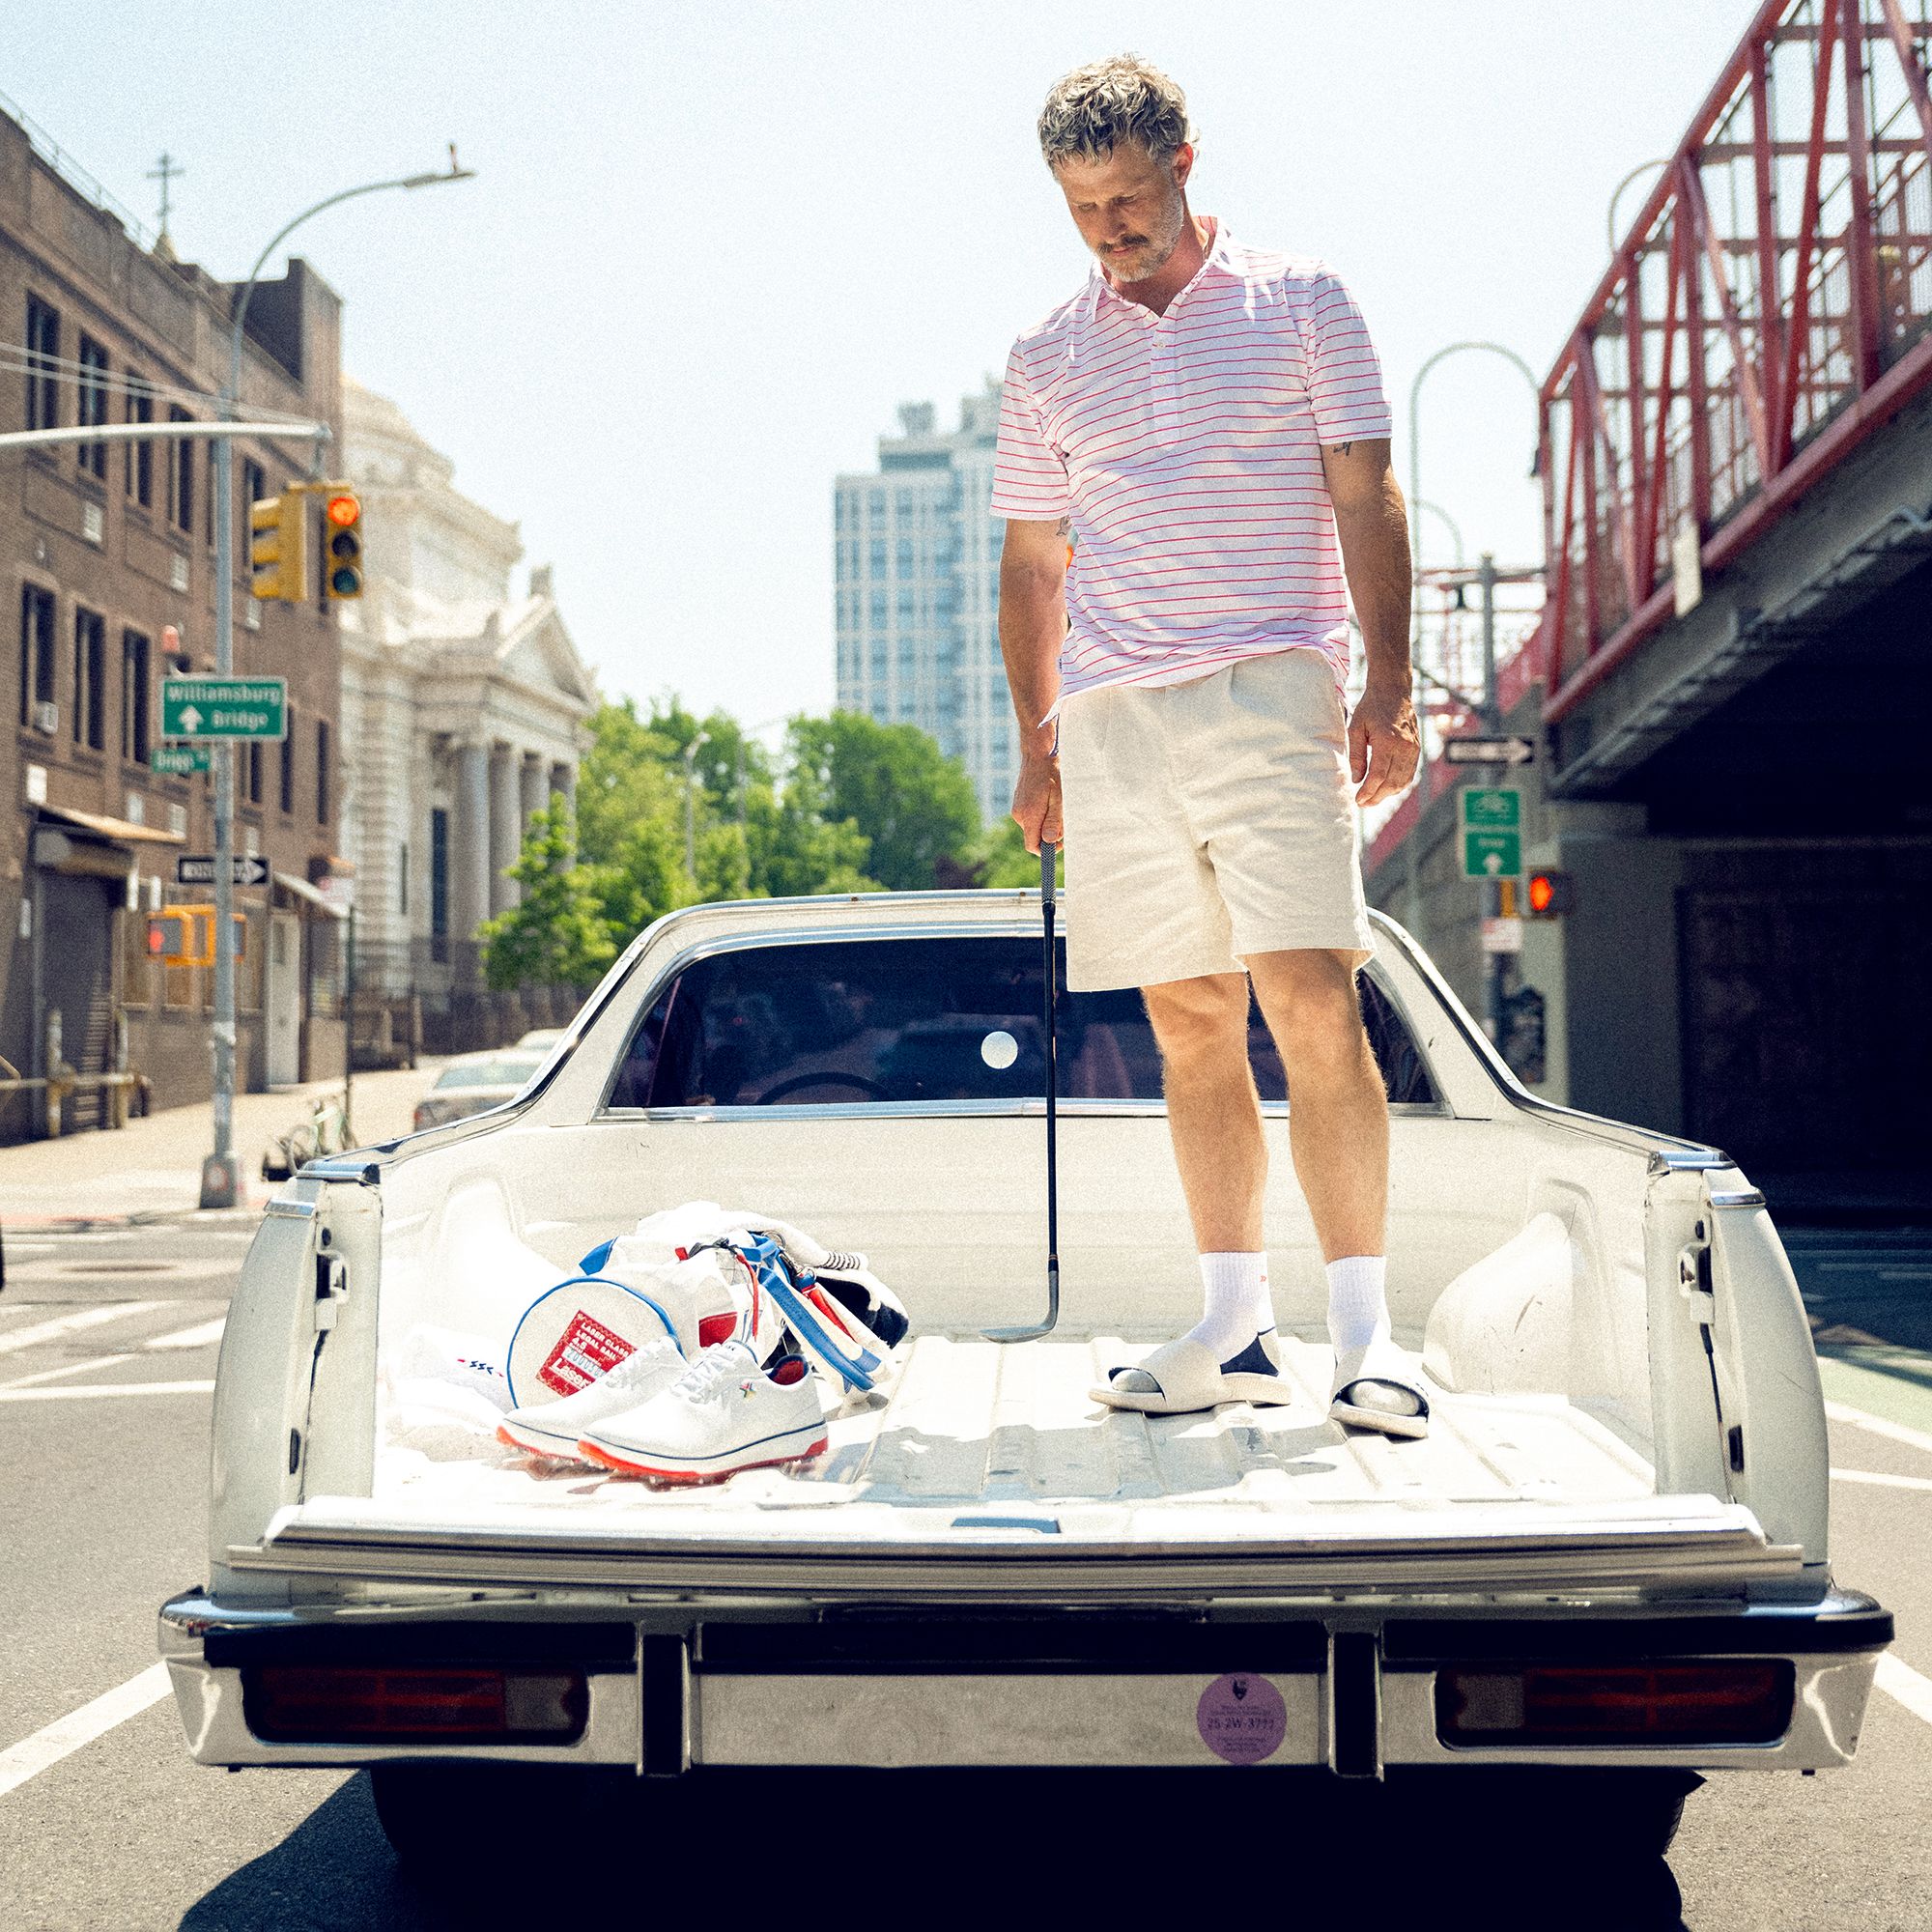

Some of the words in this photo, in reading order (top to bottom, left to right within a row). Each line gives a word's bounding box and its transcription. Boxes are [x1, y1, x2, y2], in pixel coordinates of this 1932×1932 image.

[167, 685, 280, 706] Williamsburg
[212, 709, 269, 732] Bridge
[571, 1336, 587, 1350] 4.5
[575, 1329, 600, 1350] LEGAL
[599, 1346, 616, 1361] SAIL
[581, 1321, 606, 1342] LASER
[604, 1338, 630, 1358] CLASS
[550, 1357, 592, 1388] Laser
